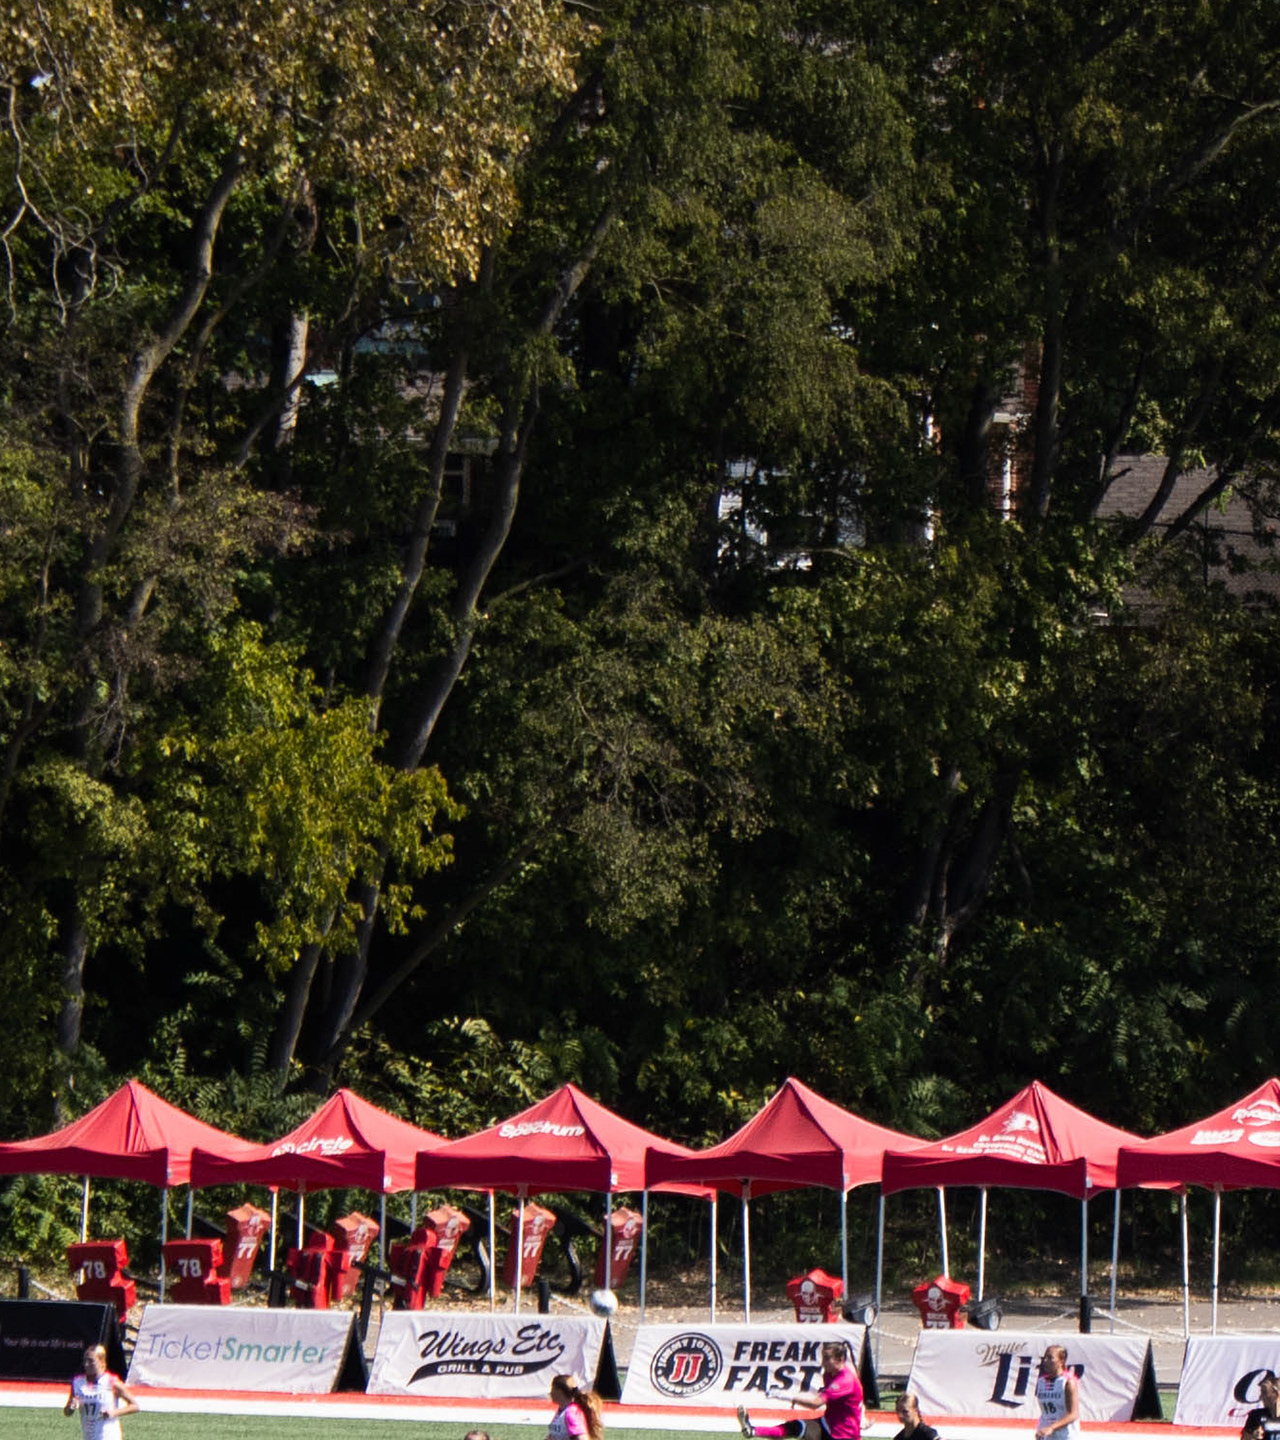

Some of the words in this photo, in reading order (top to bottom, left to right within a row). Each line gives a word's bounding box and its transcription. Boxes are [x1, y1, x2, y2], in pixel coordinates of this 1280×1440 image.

[237, 1242, 258, 1260] 77
[522, 1241, 542, 1258] 77
[613, 1245, 632, 1261] 77
[81, 1261, 106, 1279] 78
[178, 1259, 202, 1277] 78
[147, 1333, 328, 1364] TicketSmarter
[418, 1331, 506, 1361] Wings
[437, 1364, 476, 1374] GRILL
[481, 1364, 491, 1373] &
[495, 1365, 524, 1375] PUB
[669, 1353, 704, 1384] JJ
